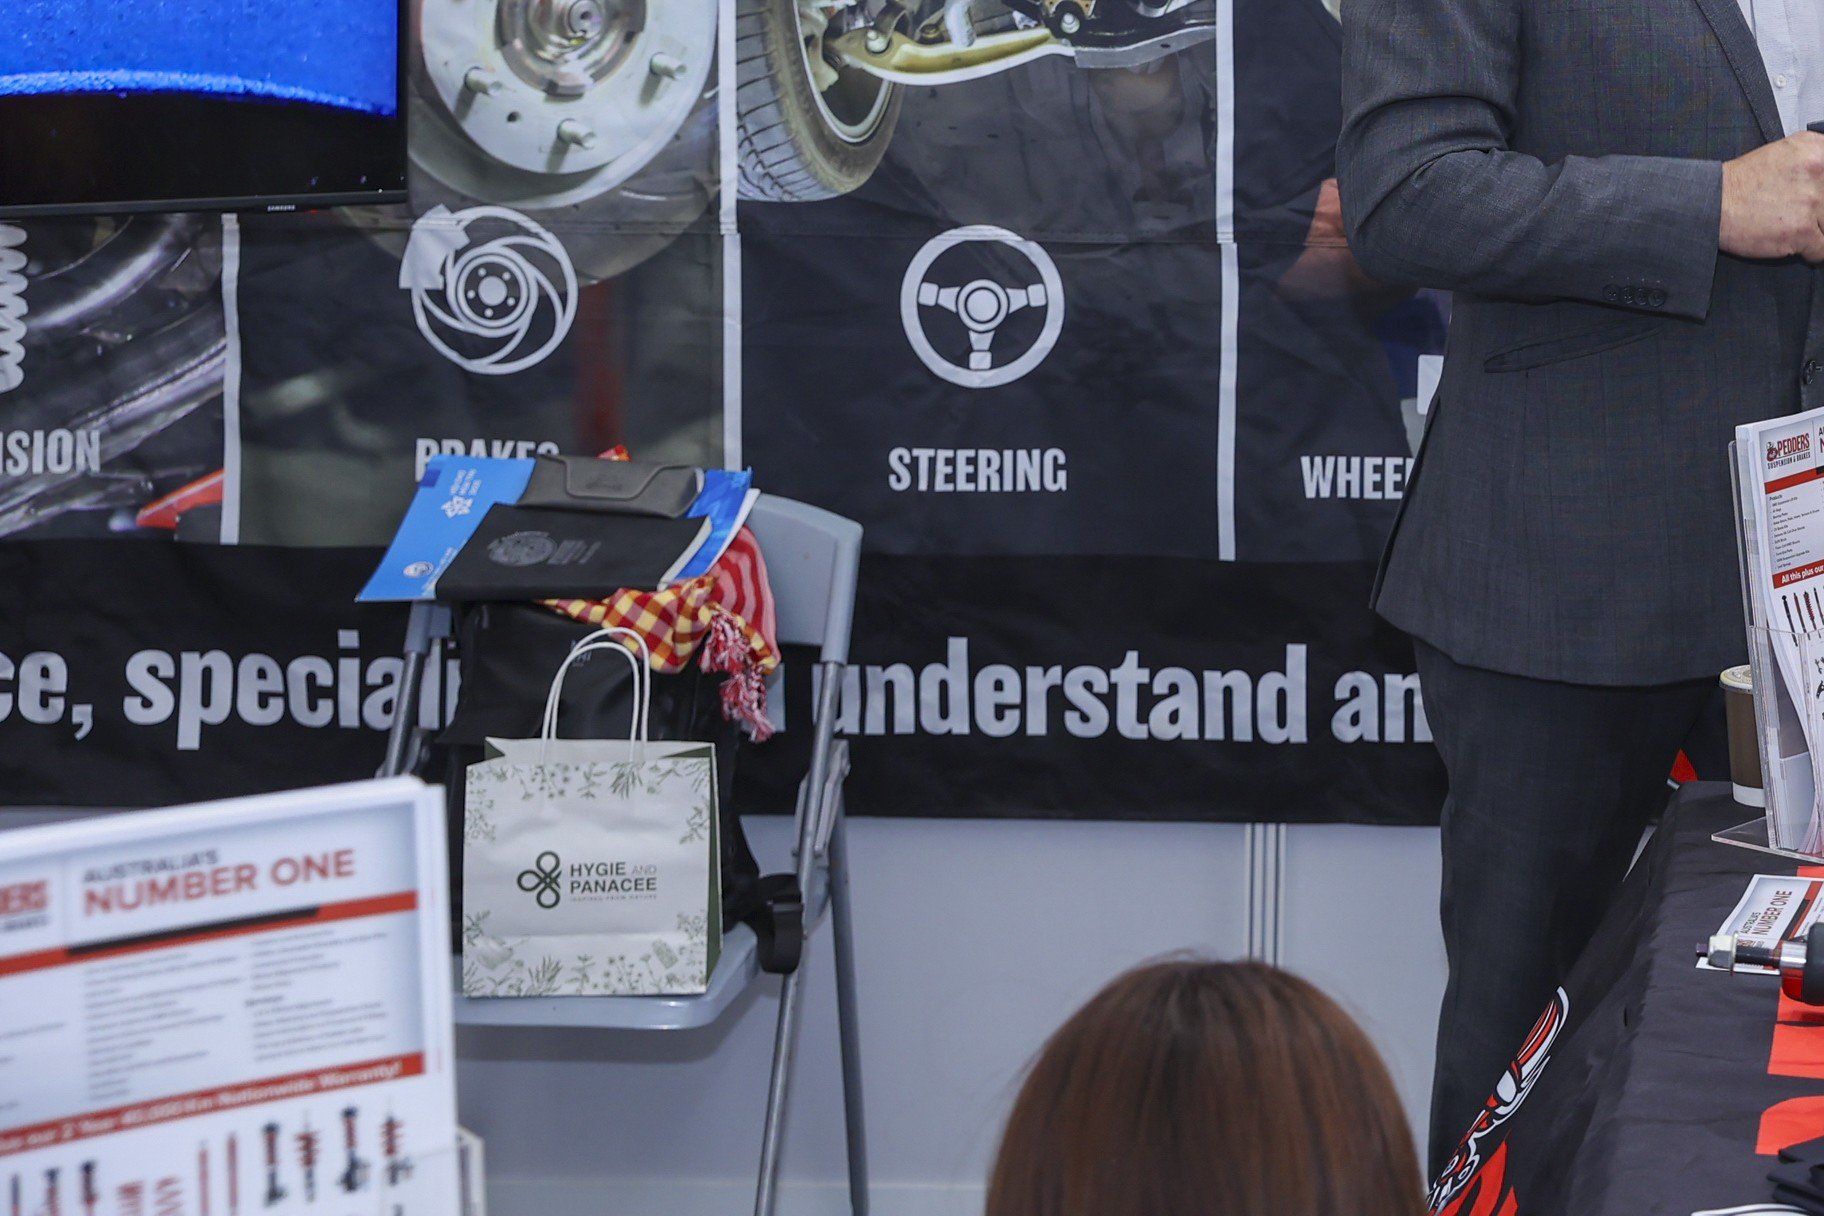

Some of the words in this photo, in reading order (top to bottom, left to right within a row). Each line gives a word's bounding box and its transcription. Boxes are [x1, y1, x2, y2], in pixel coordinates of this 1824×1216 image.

[0, 427, 100, 477] SION
[1776, 432, 1810, 457] PEDDERS
[887, 447, 1068, 493] STEERING
[1790, 570, 1802, 581] this
[1802, 567, 1814, 578] plus
[1814, 564, 1824, 574] our
[811, 636, 1308, 744] understand
[84, 849, 219, 884] AUSTRALIA'S
[84, 862, 257, 917] NUMBER
[270, 848, 357, 886] ONE
[570, 862, 626, 877] HYGIE
[570, 878, 657, 894] PANACEE
[1751, 905, 1783, 935] NUMBER
[1775, 890, 1793, 912] ONE
